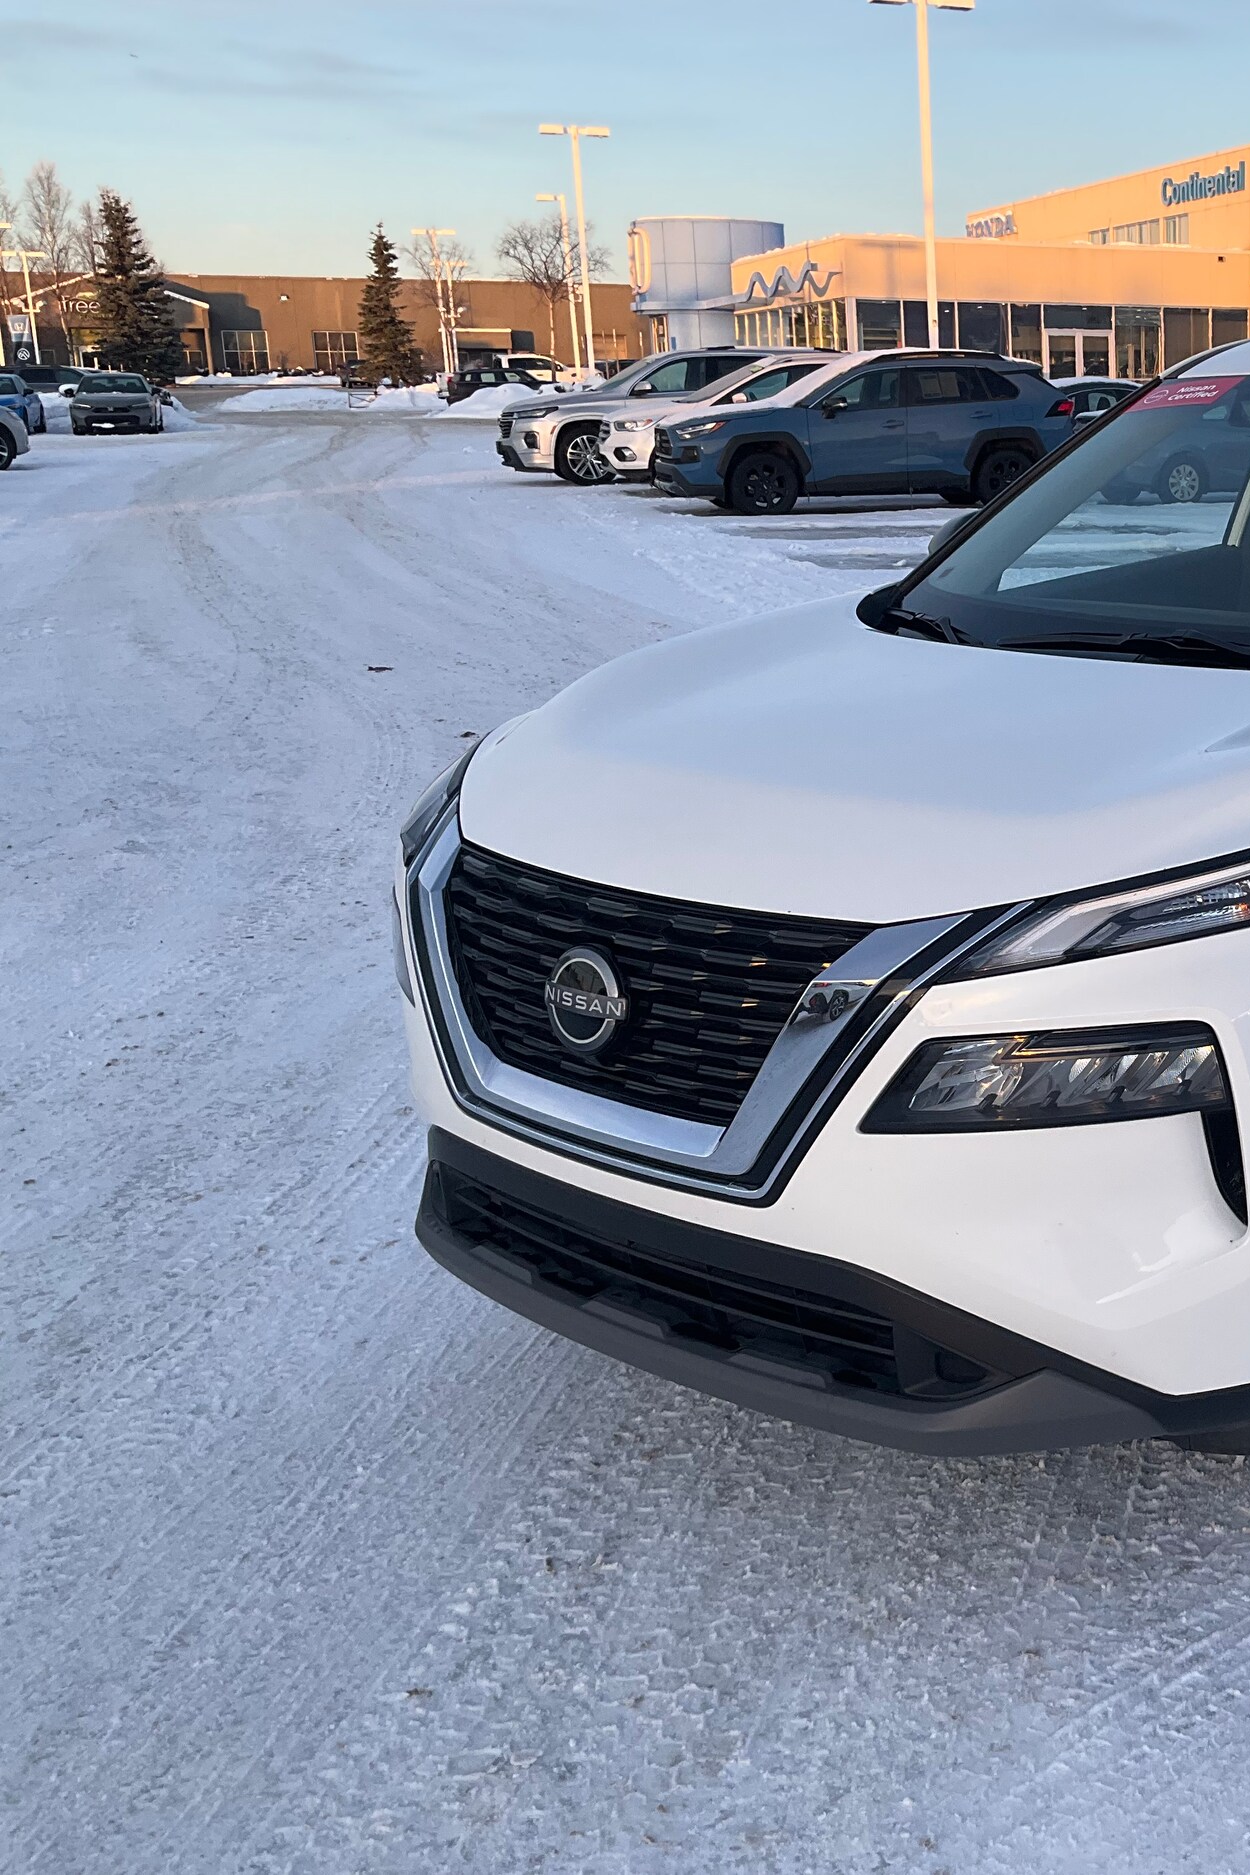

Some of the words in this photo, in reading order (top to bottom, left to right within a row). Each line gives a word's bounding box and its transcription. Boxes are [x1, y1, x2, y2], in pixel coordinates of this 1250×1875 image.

[1161, 161, 1246, 207] Continental
[965, 213, 1016, 239] HONDA
[1167, 390, 1219, 401] Certified
[1176, 384, 1218, 394] Nissan
[545, 984, 622, 1017] NISSAN
